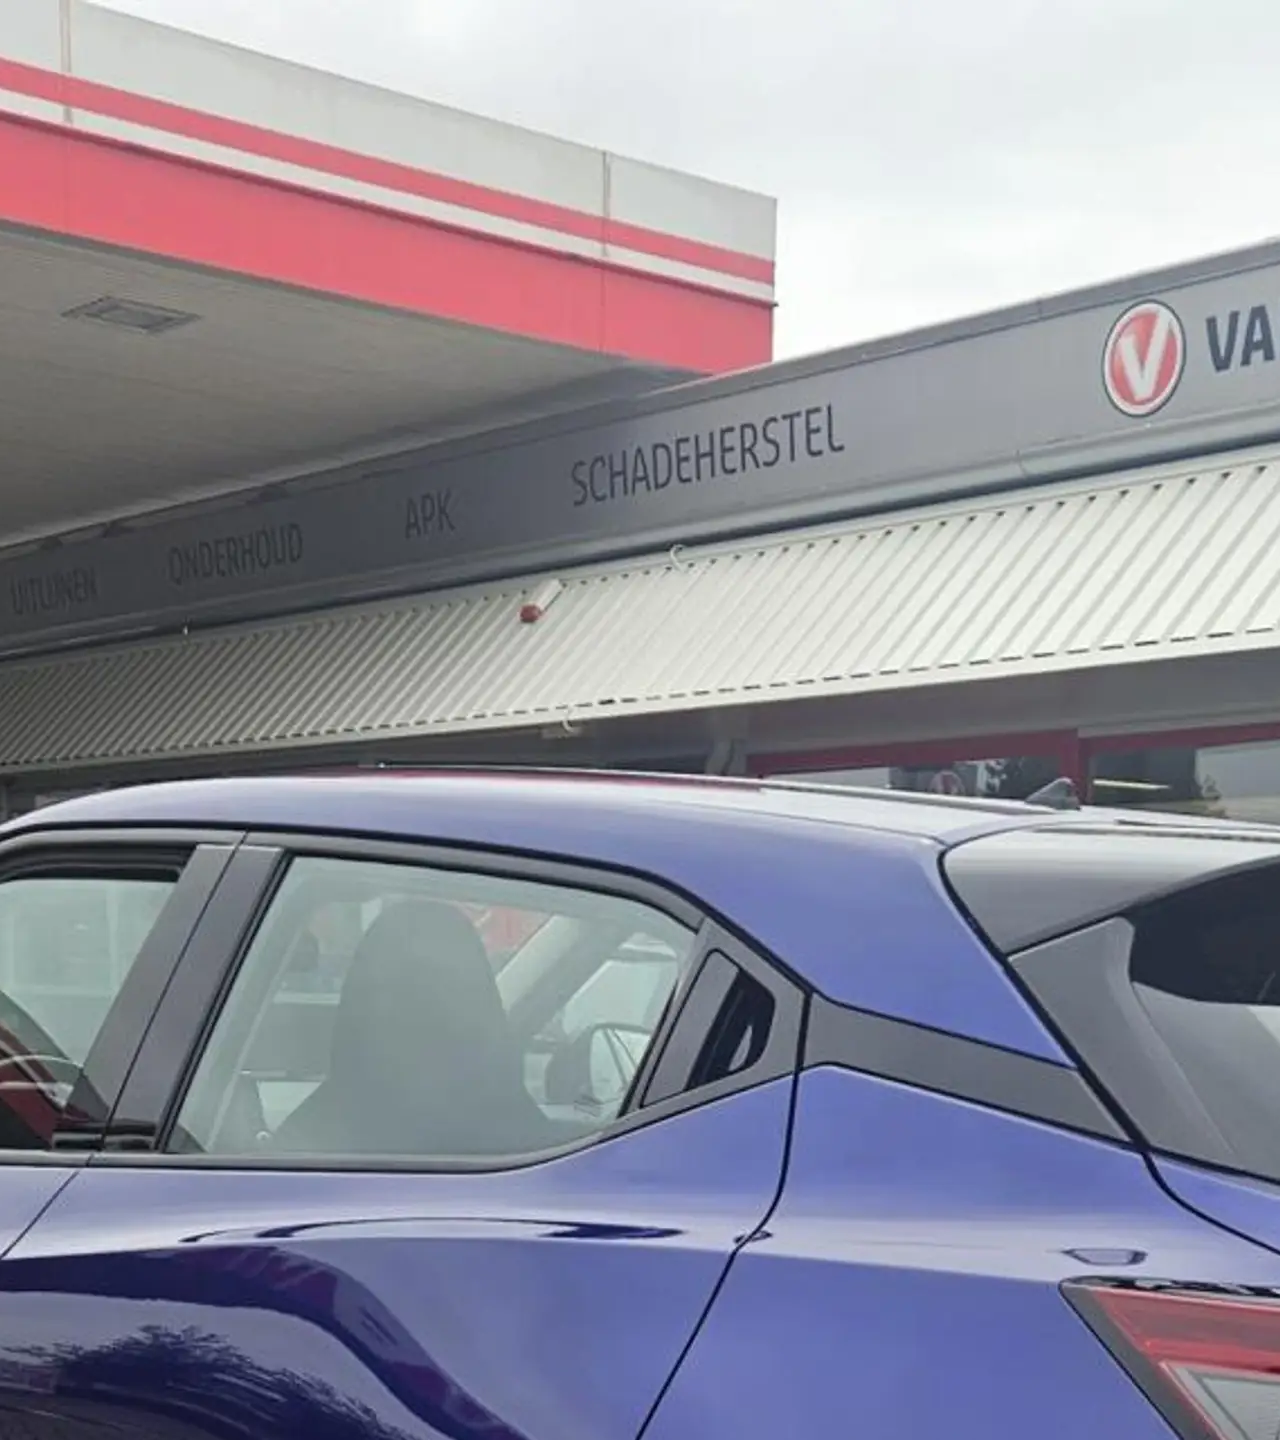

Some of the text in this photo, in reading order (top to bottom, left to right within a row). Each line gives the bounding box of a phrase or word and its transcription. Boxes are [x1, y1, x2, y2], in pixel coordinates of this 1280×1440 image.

[169, 522, 304, 586] ONDERHOUD
[404, 489, 457, 540] APK
[571, 403, 845, 507] SCHADEHERSTEL
